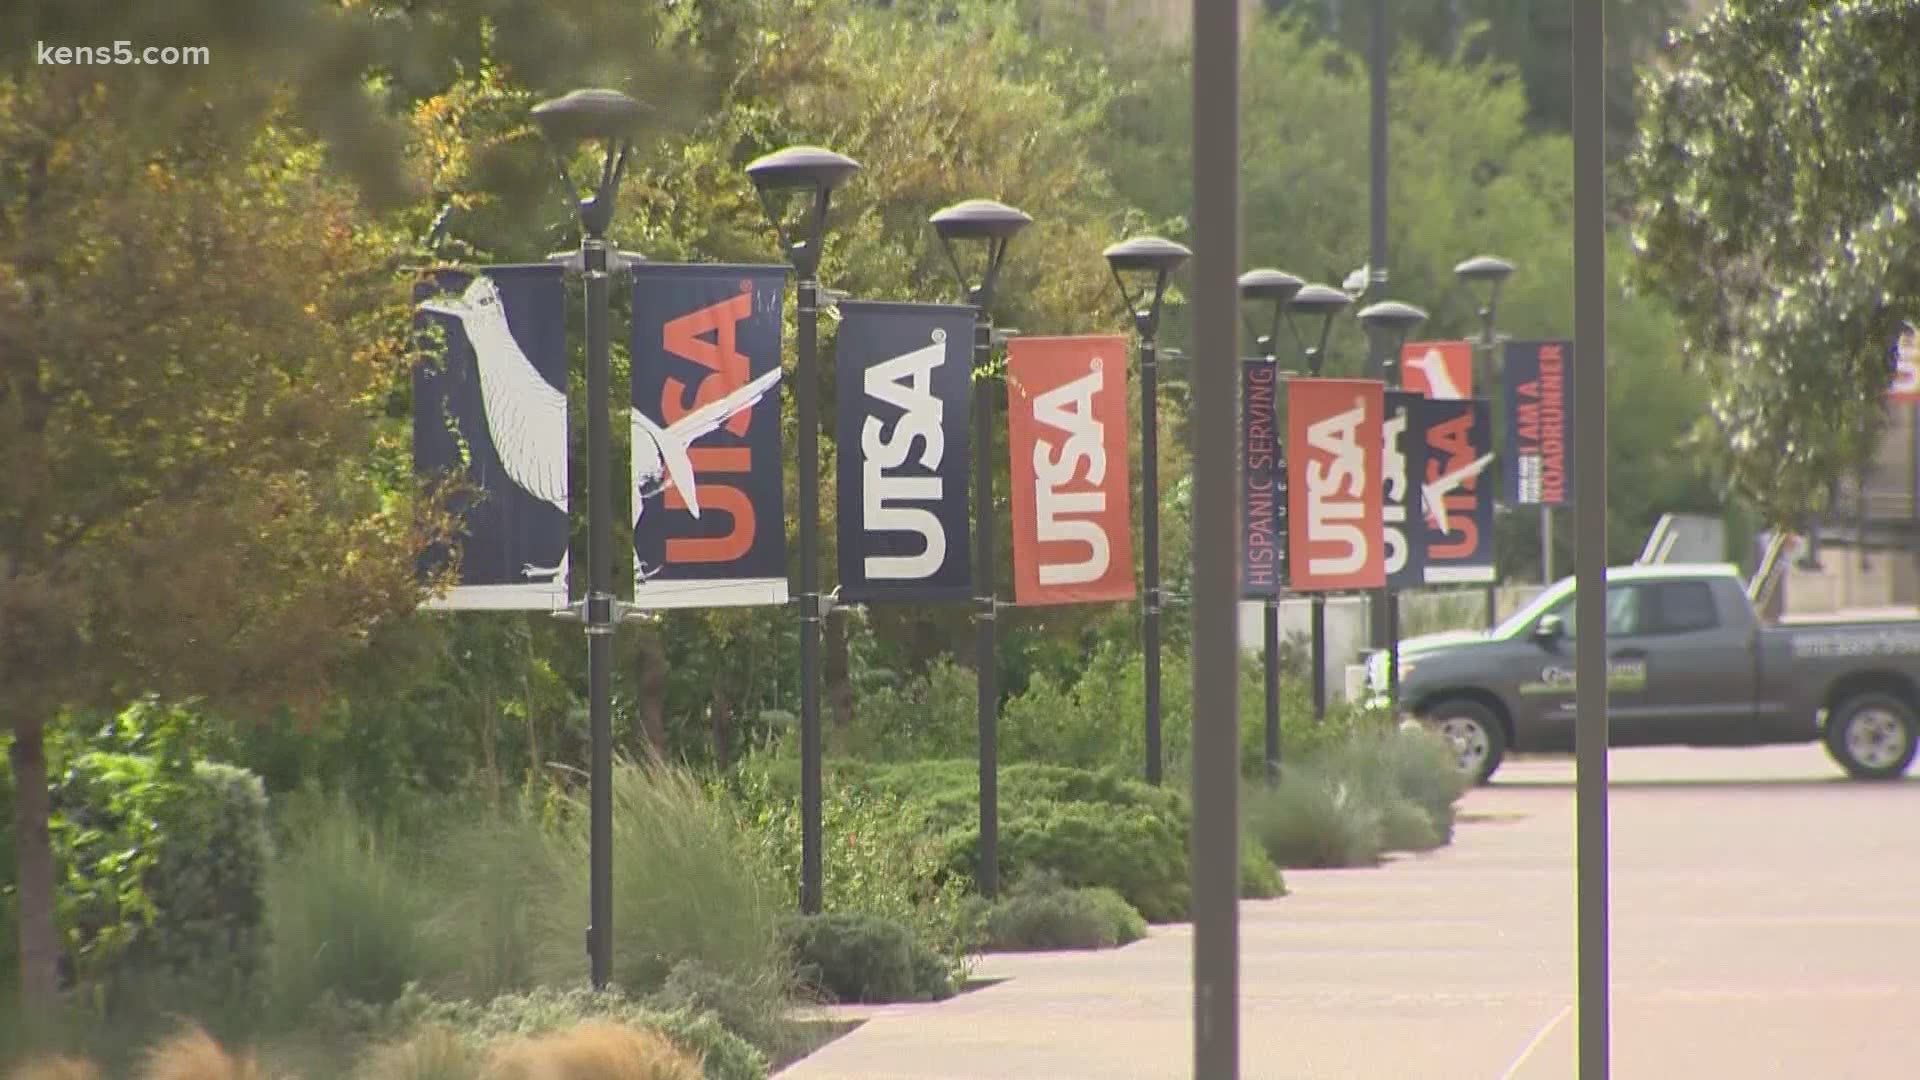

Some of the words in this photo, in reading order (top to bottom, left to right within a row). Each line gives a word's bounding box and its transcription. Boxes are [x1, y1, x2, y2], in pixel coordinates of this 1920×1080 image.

[861, 342, 947, 579] UTSA
[1033, 370, 1111, 586] UTSA
[1247, 367, 1274, 471] SERVING
[1306, 407, 1368, 576] UTSA
[1539, 344, 1564, 503] ROADRUNNER
[1247, 477, 1273, 585] HISPANIC
